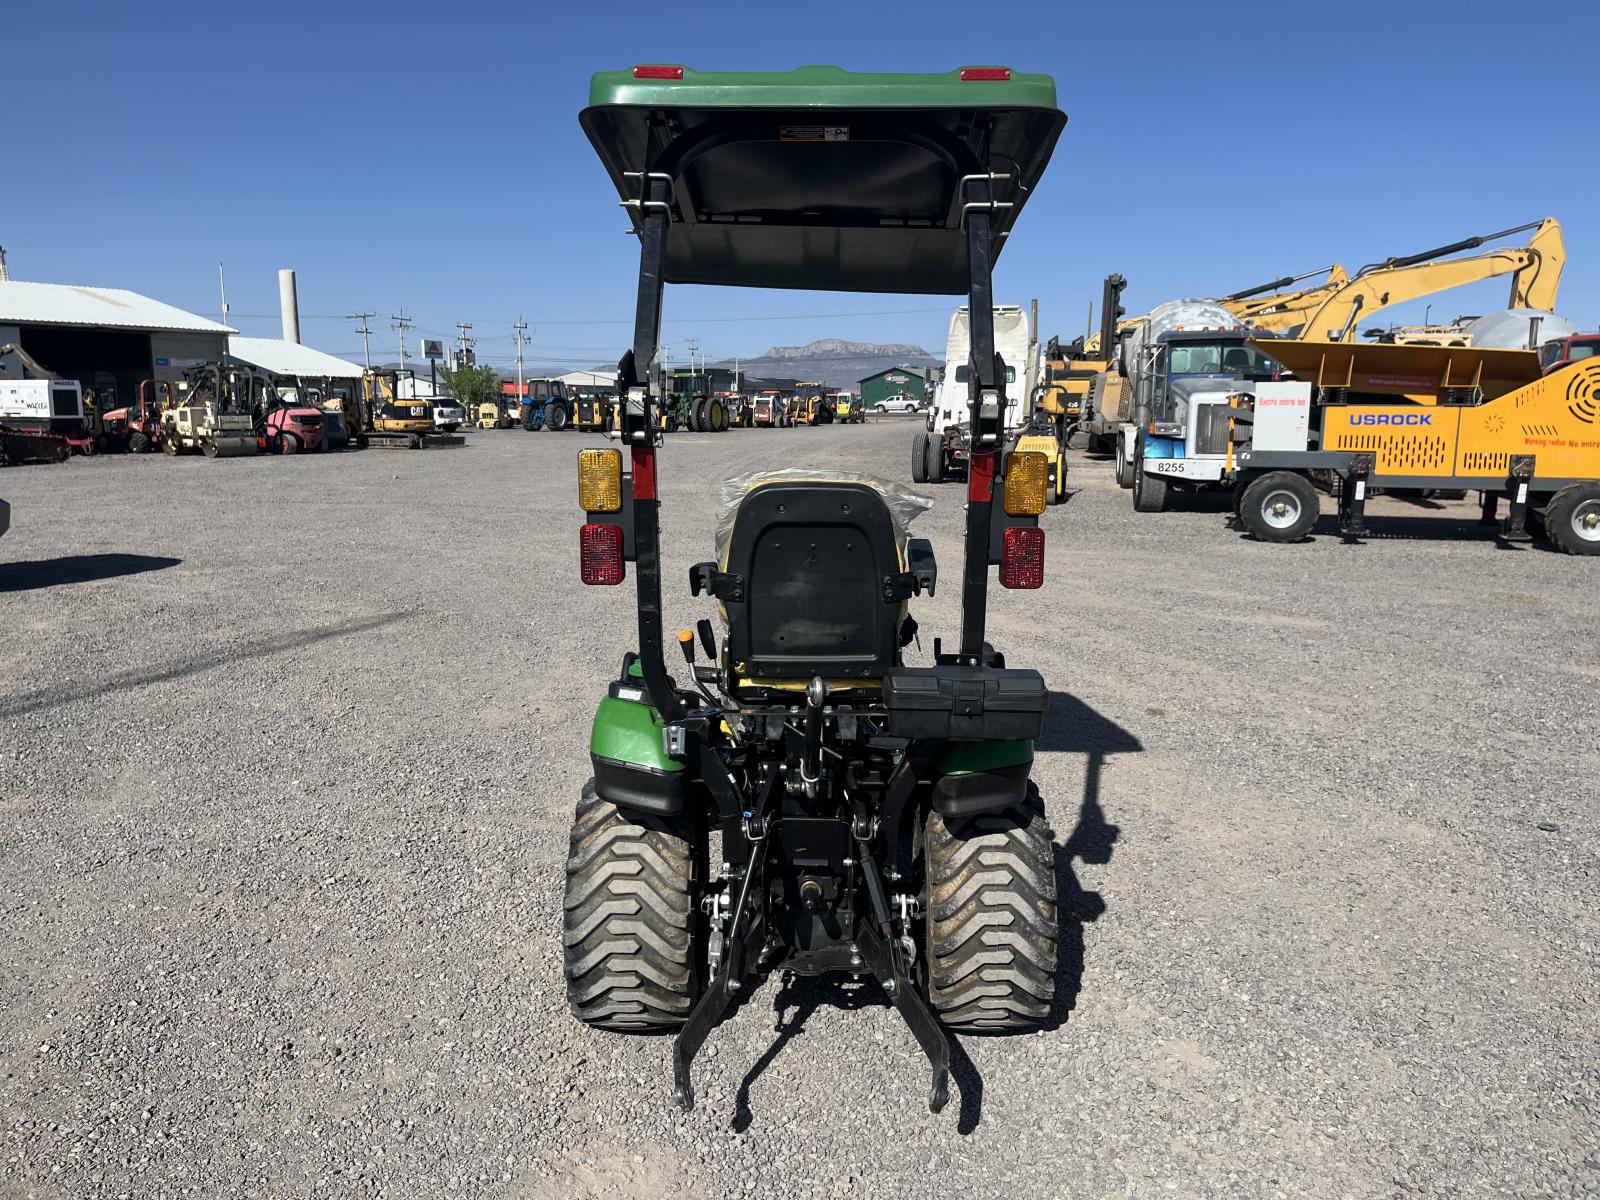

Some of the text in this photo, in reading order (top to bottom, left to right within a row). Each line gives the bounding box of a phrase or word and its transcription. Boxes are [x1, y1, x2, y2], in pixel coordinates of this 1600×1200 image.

[410, 406, 424, 417] CAT
[1350, 414, 1432, 426] USROCK
[1568, 440, 1579, 448] No
[1581, 440, 1600, 449] entry
[1157, 462, 1185, 473] 8255
